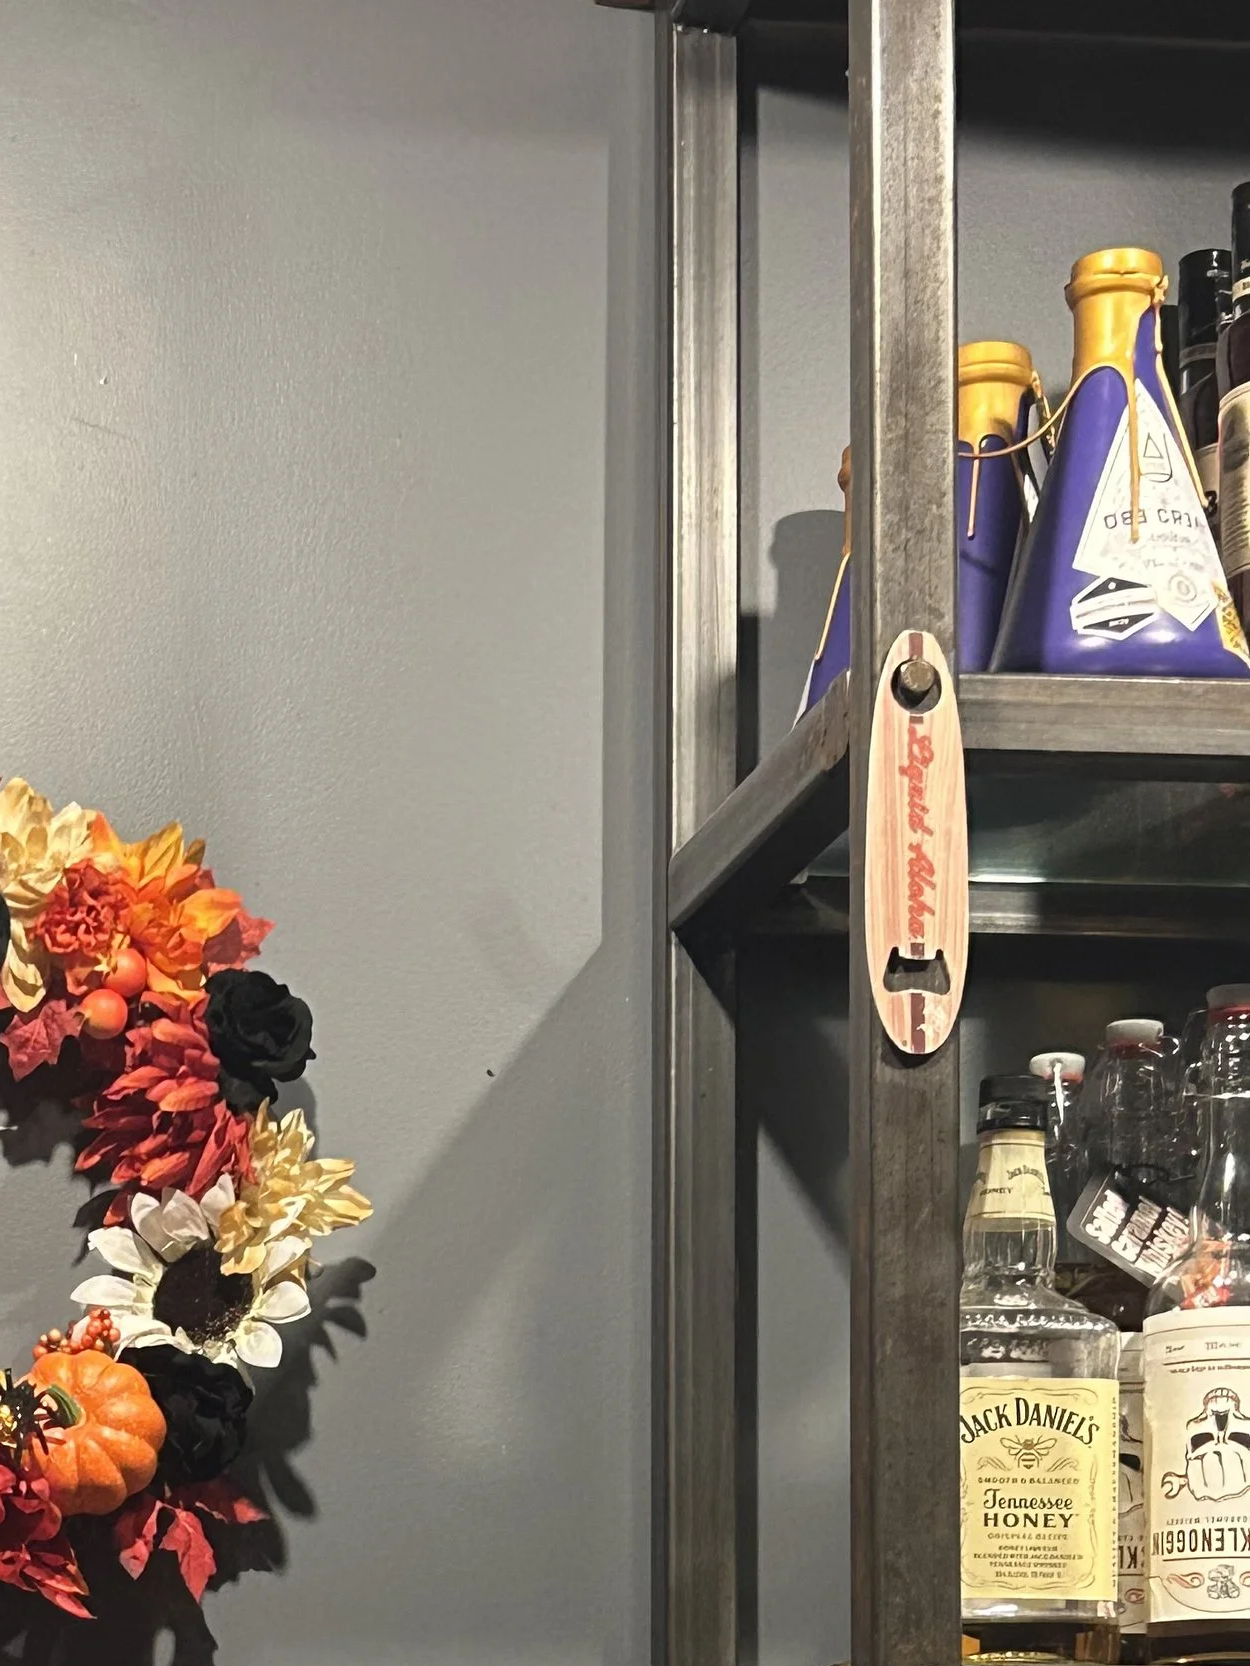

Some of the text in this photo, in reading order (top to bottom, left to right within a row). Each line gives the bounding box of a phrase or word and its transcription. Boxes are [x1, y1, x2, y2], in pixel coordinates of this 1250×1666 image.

[960, 1397, 1100, 1446] JACK DANIEL'S
[983, 1488, 1074, 1510] Tennessee
[983, 1512, 1074, 1529] HONEY
